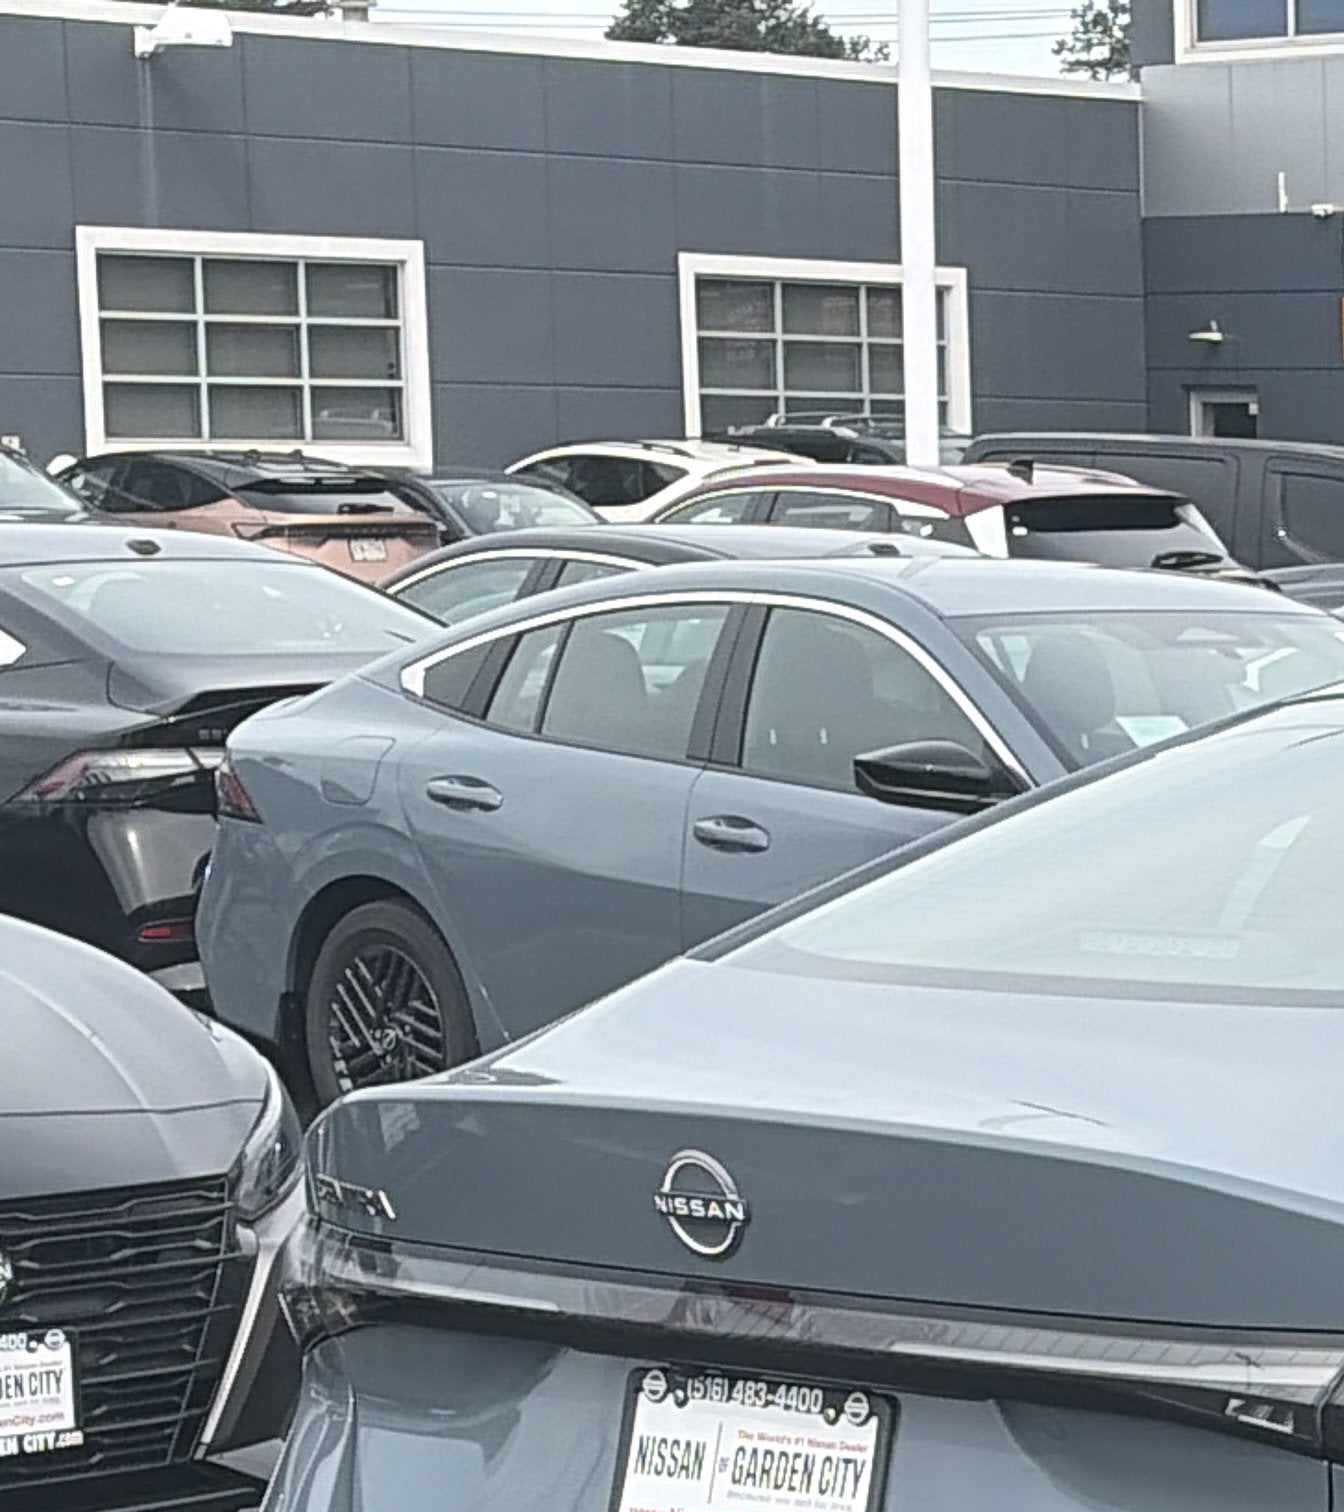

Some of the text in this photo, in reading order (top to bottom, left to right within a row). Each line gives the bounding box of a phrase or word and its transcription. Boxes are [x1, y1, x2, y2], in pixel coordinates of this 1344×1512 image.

[653, 1194, 746, 1221] NISSAN
[29, 1368, 63, 1397] CITY
[687, 1376, 824, 1414] (516) 483-4400
[633, 1434, 707, 1482] NISSAN
[731, 1445, 817, 1495] GARDEN
[818, 1455, 867, 1500] CITY
